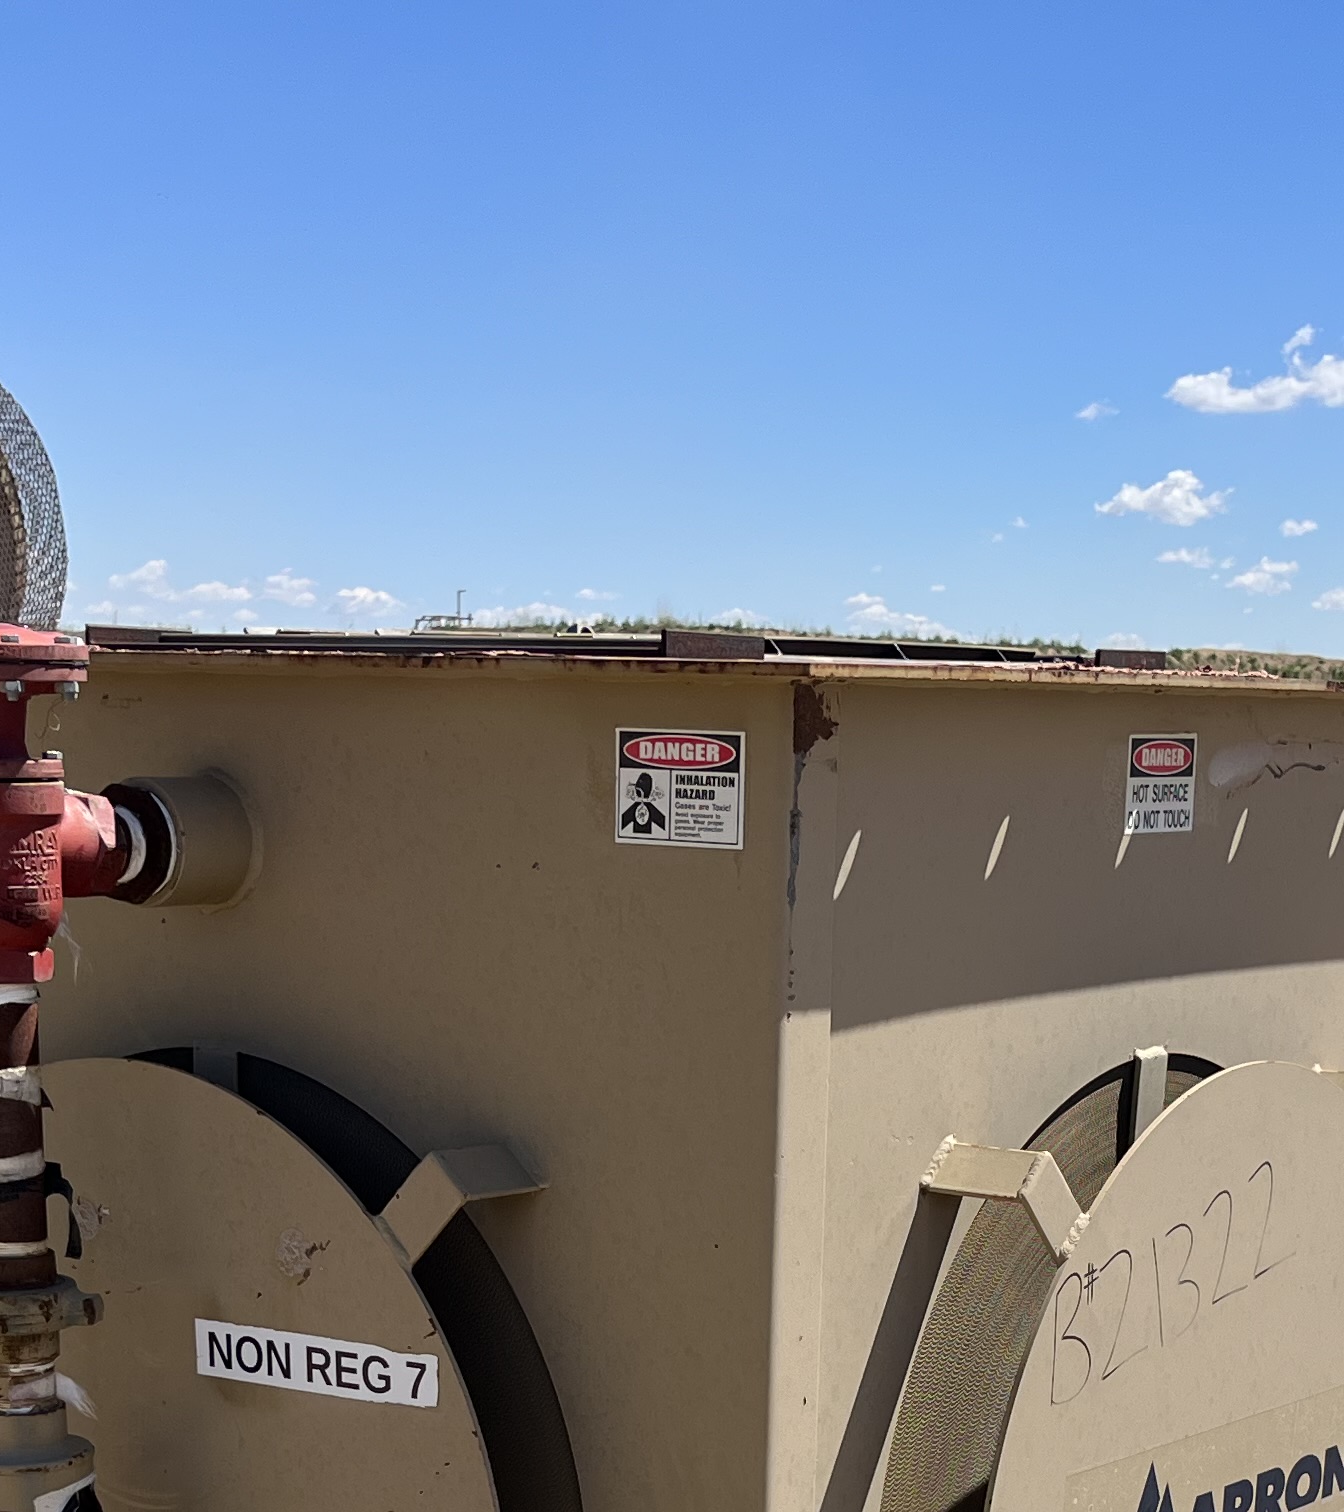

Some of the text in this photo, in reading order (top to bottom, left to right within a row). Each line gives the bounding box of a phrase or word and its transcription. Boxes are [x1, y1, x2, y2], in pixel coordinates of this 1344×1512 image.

[638, 741, 720, 762] DANGER
[1141, 748, 1185, 767] DANGER
[675, 774, 736, 788] INHALATION
[674, 788, 716, 801] HAZARD
[1132, 783, 1190, 803] HOT SURFACE
[674, 801, 696, 810] Gases
[712, 803, 732, 812] Toxic!
[1128, 809, 1190, 829] DO NOT TOUCH
[207, 1331, 427, 1399] NON REG 7
